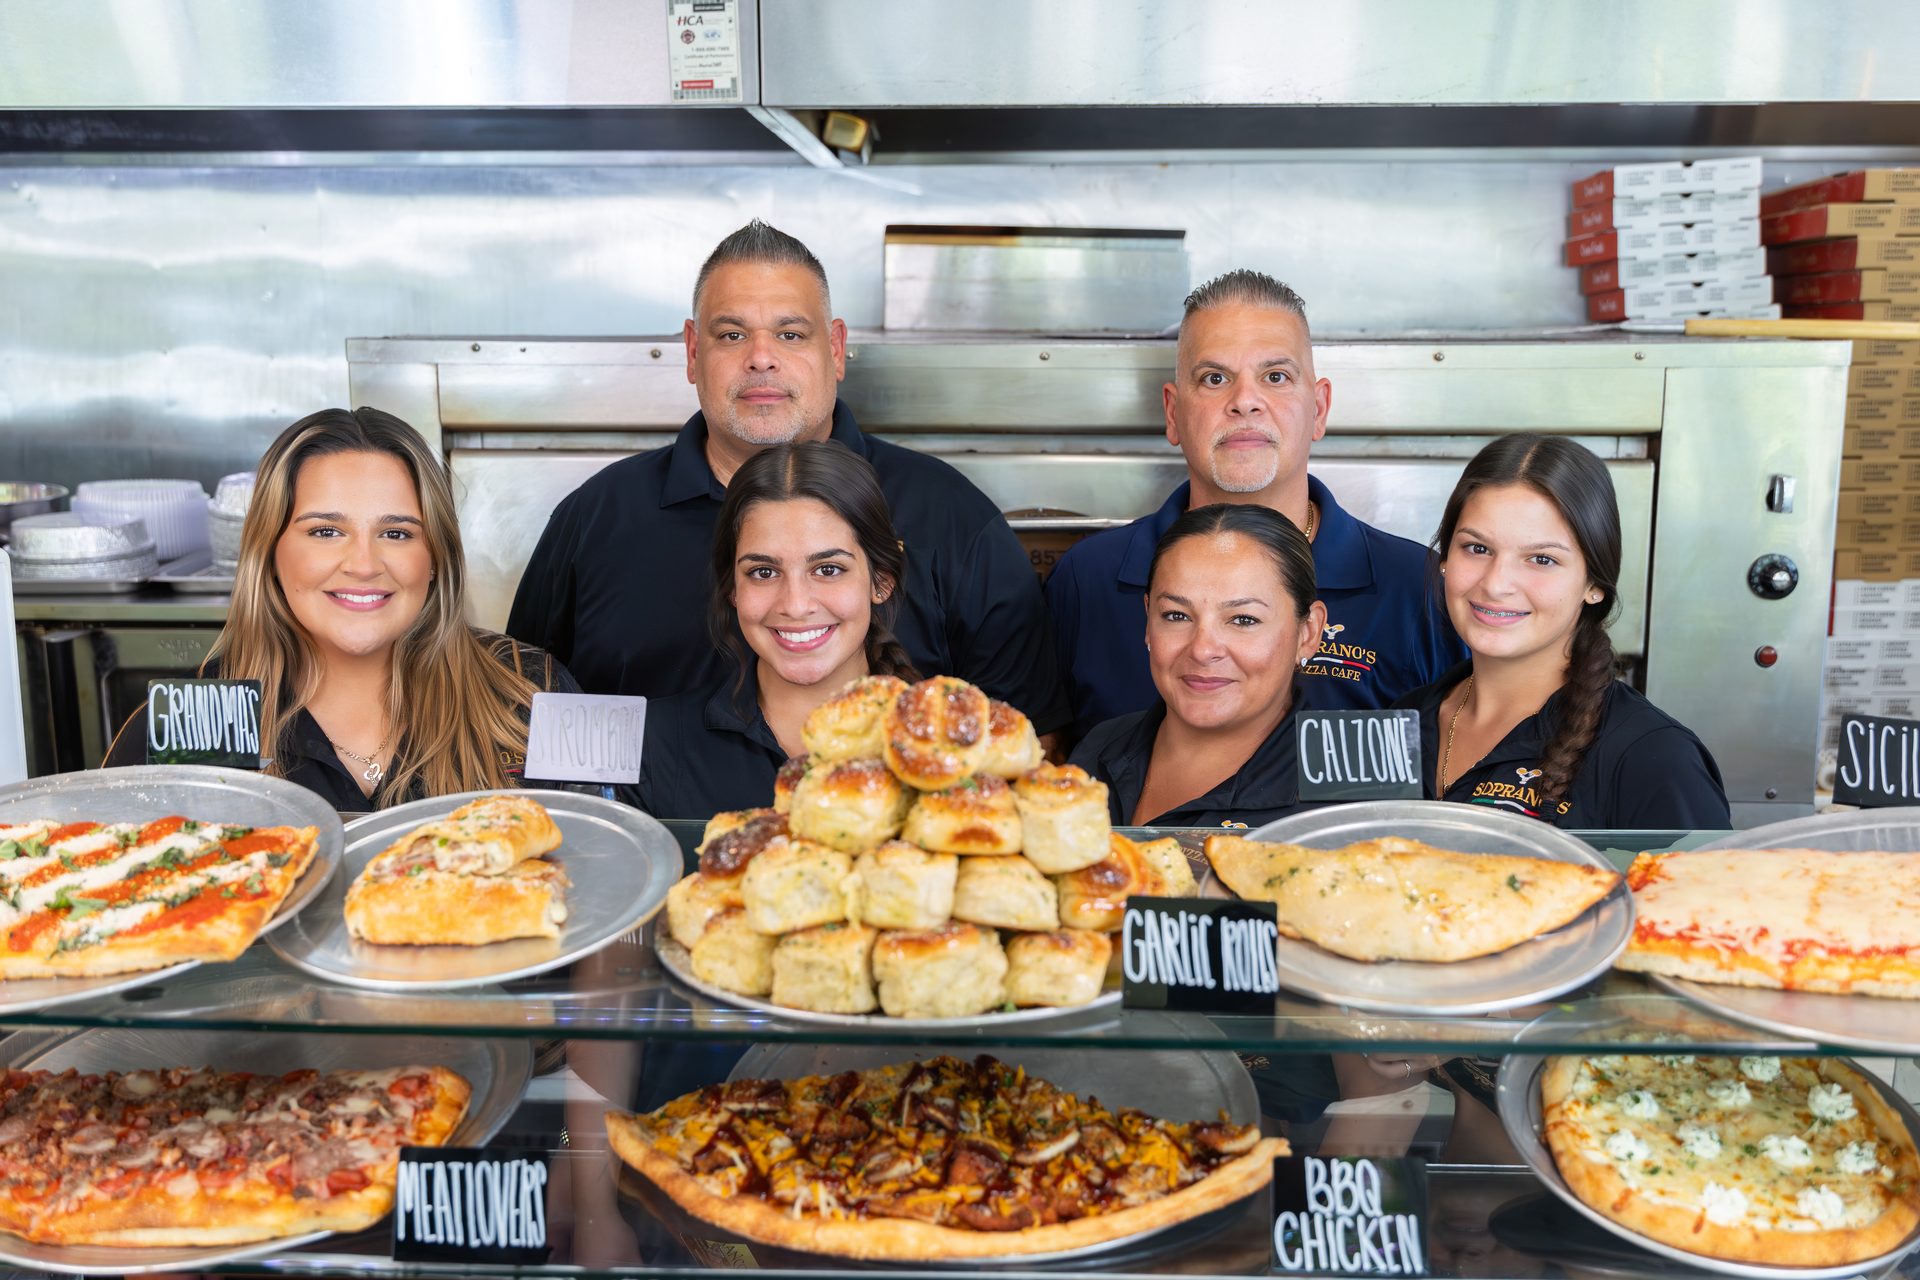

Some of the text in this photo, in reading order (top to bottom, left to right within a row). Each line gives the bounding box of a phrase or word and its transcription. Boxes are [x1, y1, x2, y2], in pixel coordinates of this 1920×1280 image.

[677, 15, 704, 26] HCA
[1317, 641, 1377, 665] RANO'S
[1331, 666, 1361, 682] CAFE
[148, 683, 260, 754] GRANDMA'S
[1300, 717, 1418, 784] CALZONE
[1220, 915, 1279, 993] ROLLS
[1304, 1156, 1383, 1218] BBQ
